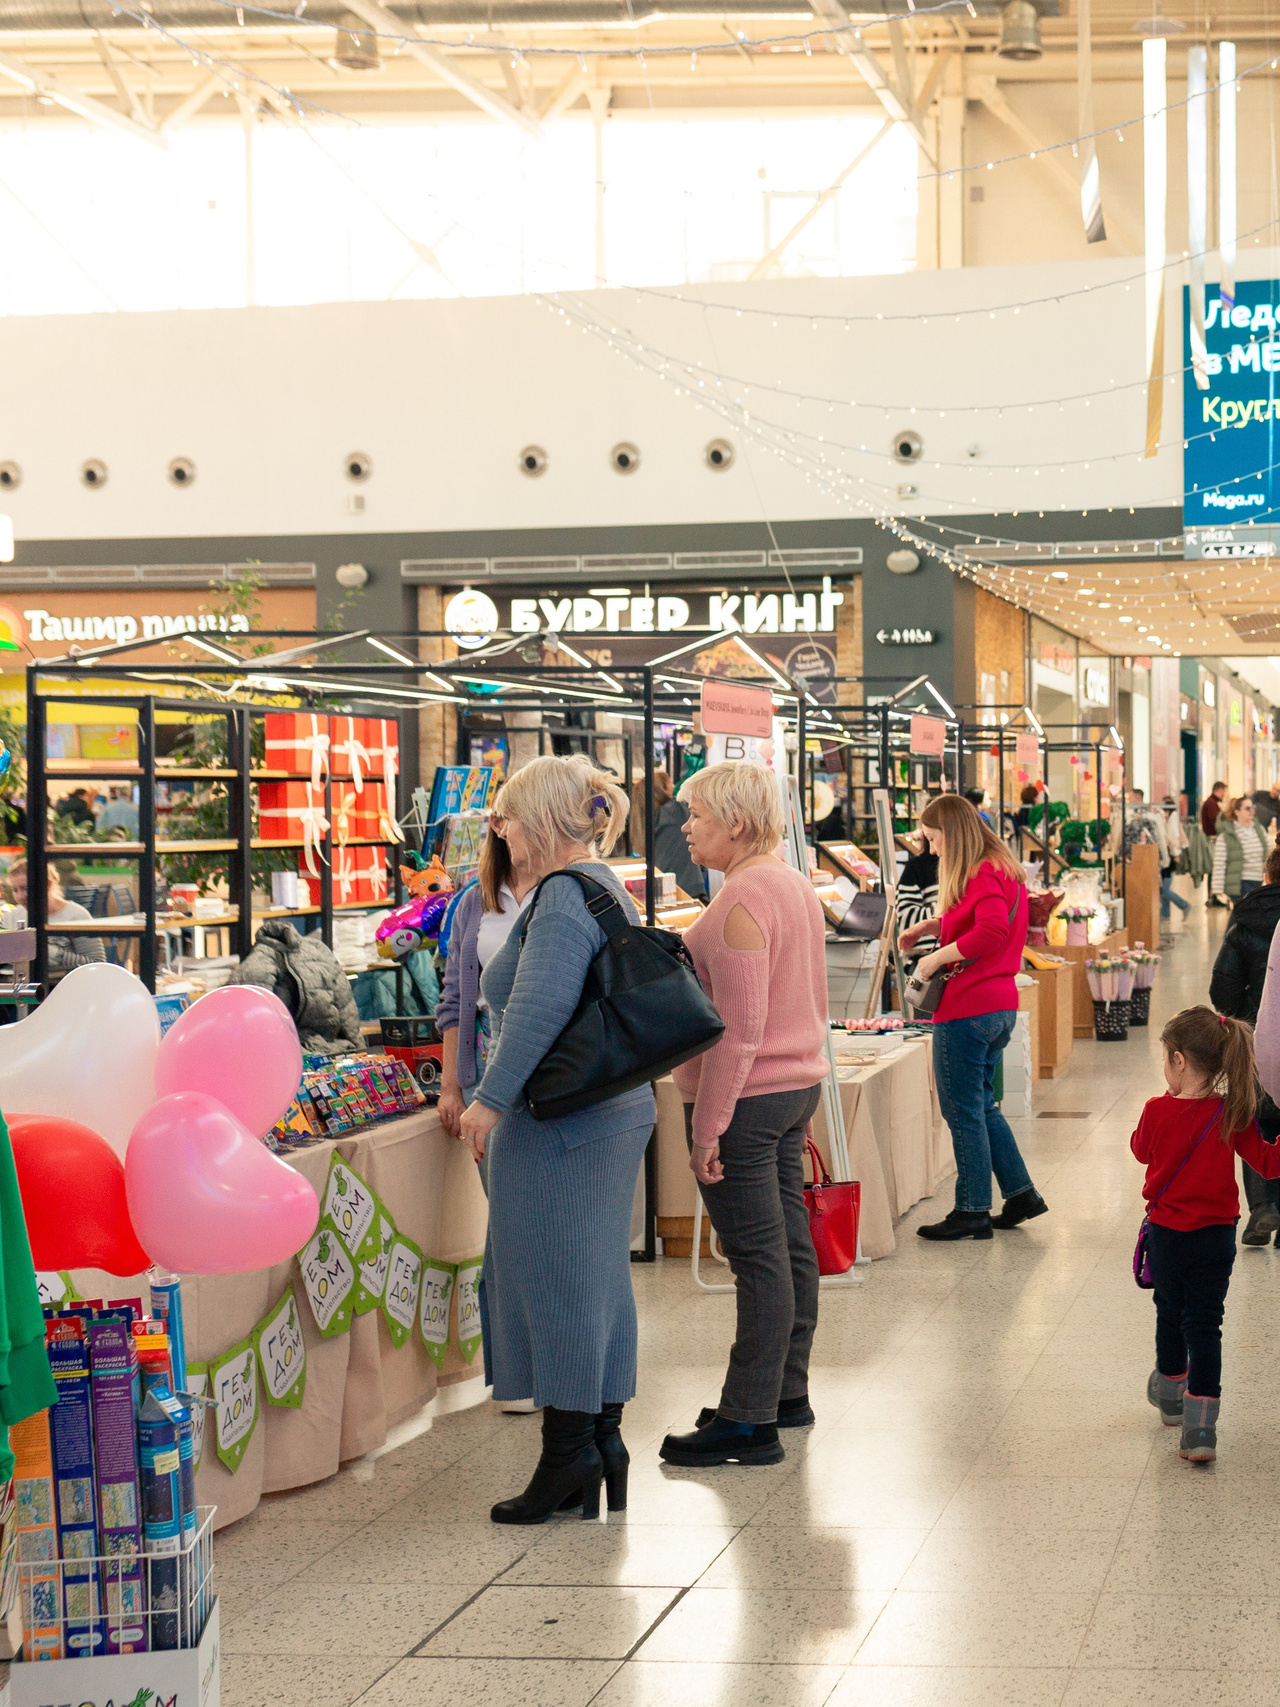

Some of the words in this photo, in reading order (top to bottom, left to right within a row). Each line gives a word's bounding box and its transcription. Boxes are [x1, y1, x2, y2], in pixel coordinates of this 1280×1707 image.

[1203, 492, 1265, 510] Mega.ru
[1201, 530, 1234, 543] ИКЕА
[511, 596, 690, 633] БУРГЕР
[709, 592, 844, 634] КИНГ
[23, 609, 138, 646] Ташир
[50, 1358, 83, 1367] БОЛЬШАЯ
